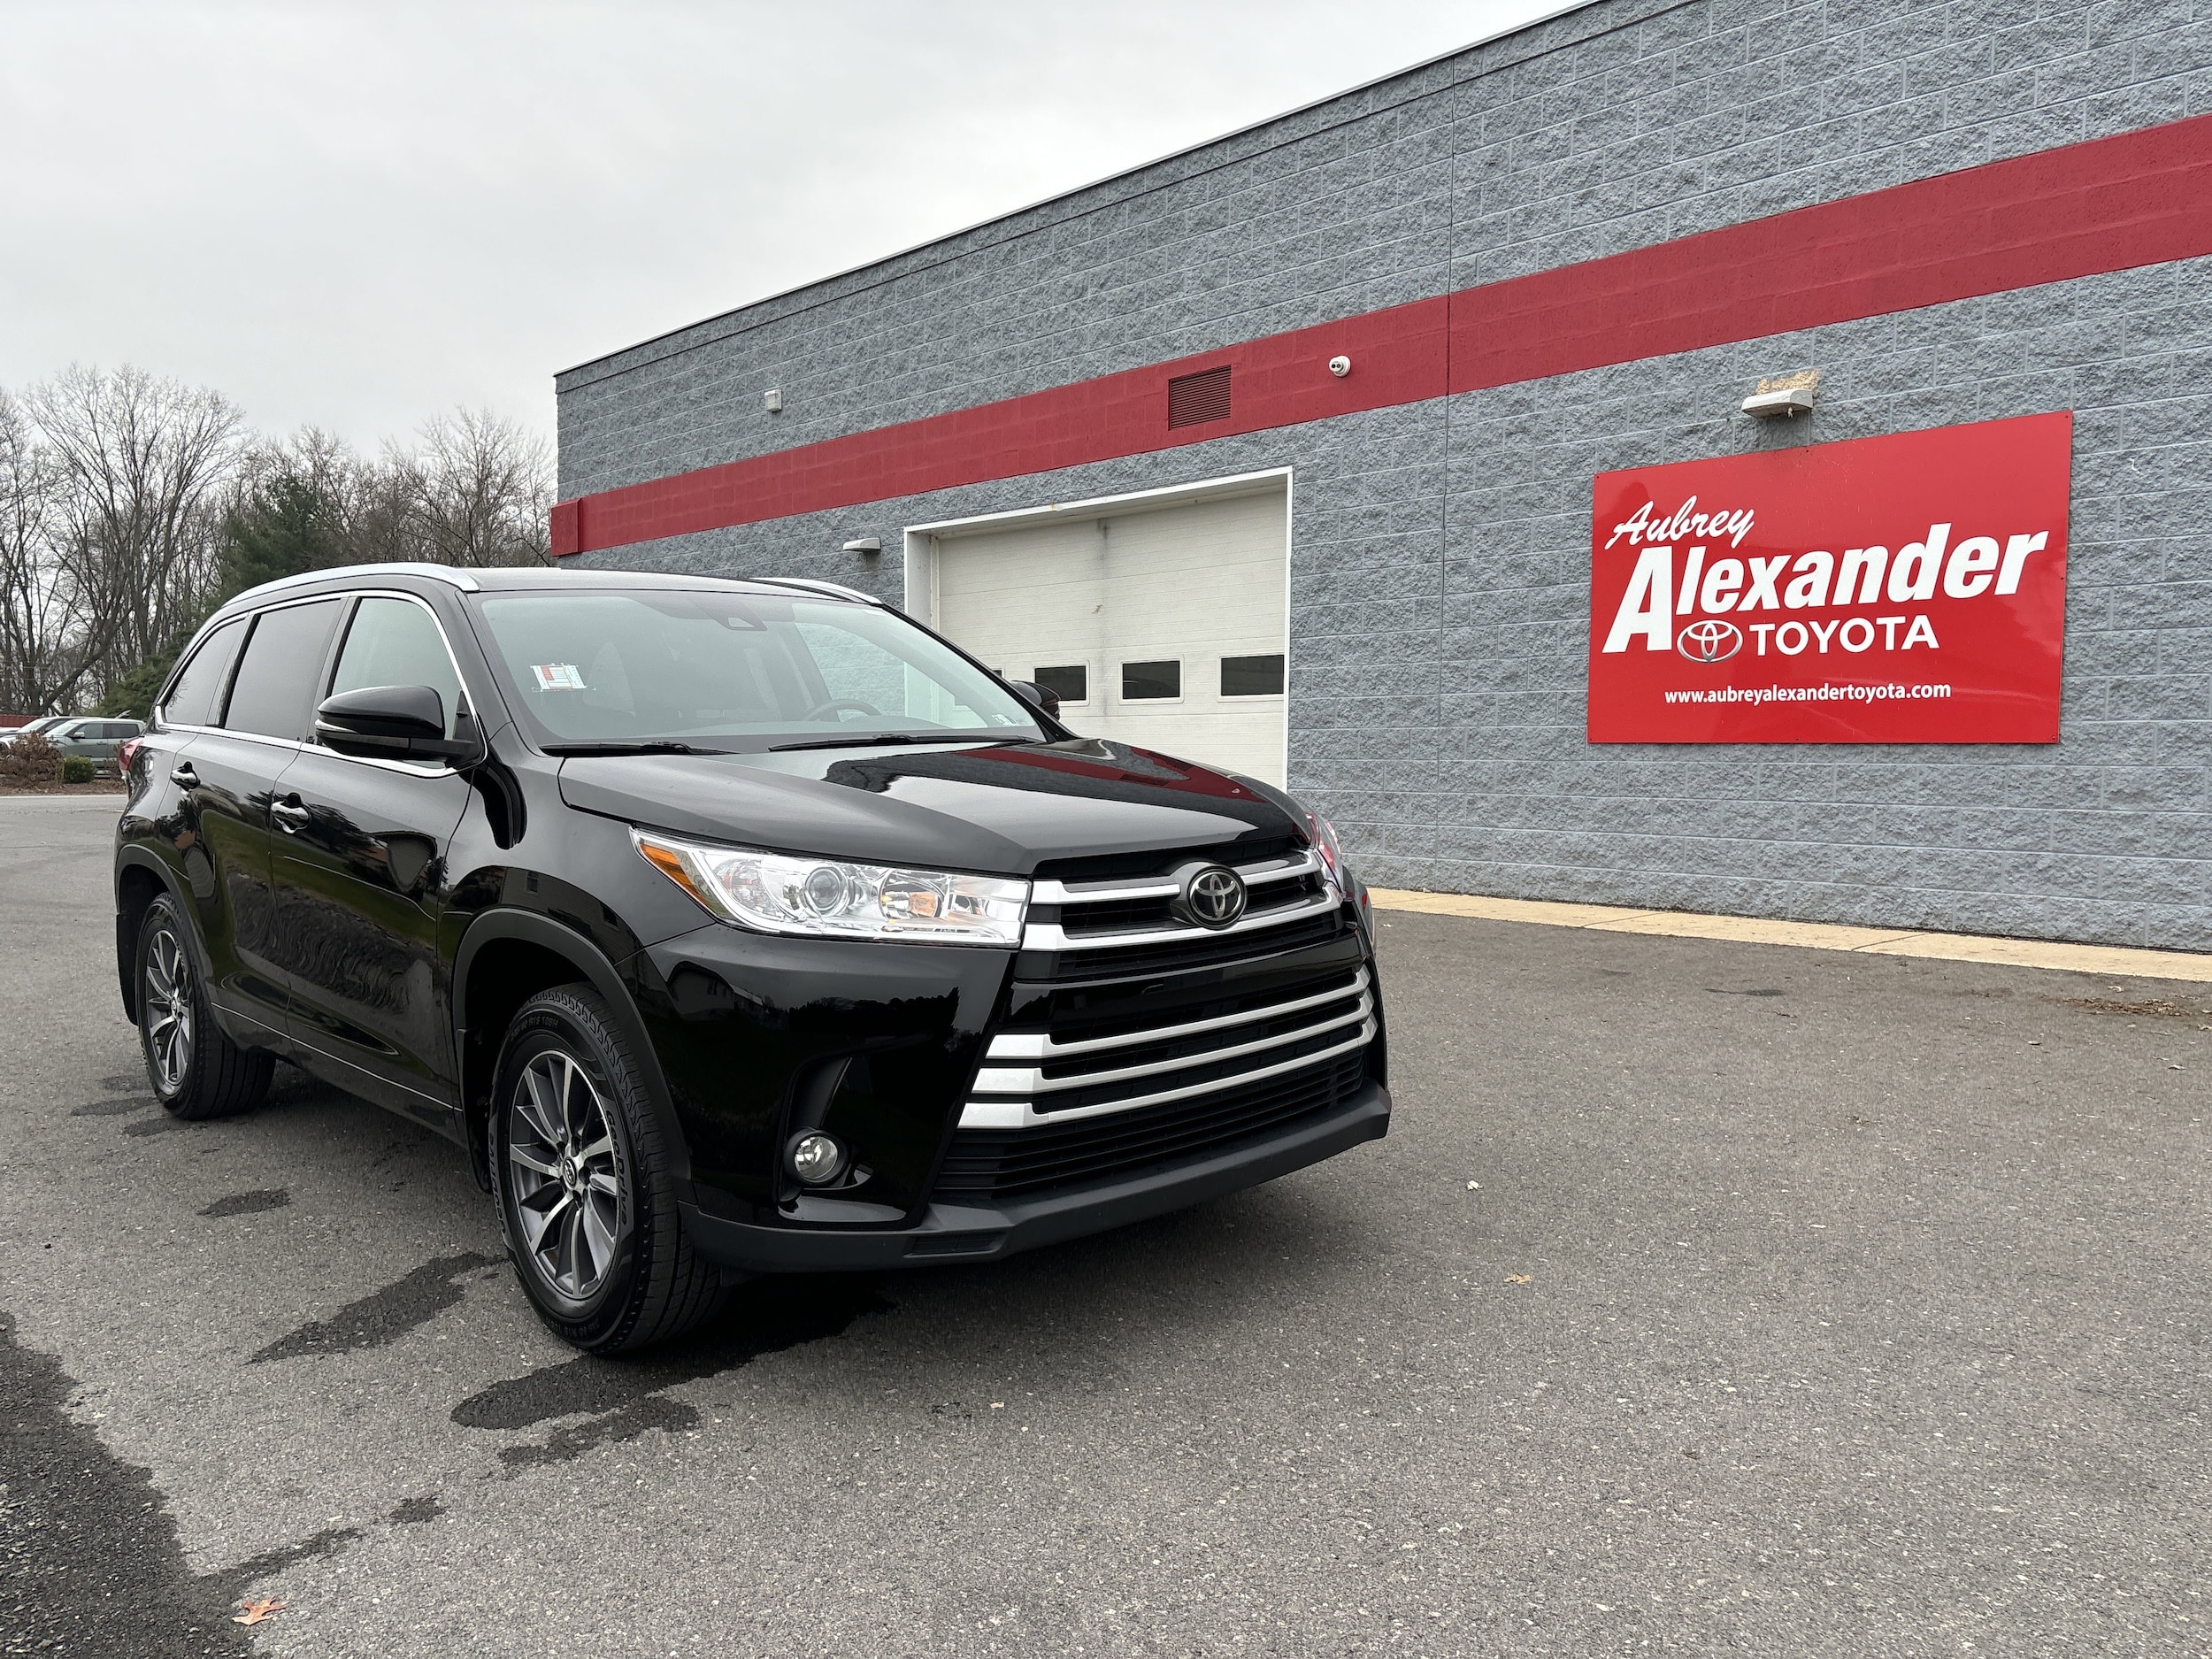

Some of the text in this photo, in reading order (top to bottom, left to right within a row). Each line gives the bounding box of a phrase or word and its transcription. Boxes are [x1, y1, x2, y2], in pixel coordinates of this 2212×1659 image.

[1605, 495, 1755, 549] Aubrey
[1602, 522, 2049, 653] Alexander
[1749, 614, 1940, 657] TOYOTA
[1664, 682, 1951, 706] www.aubreyalexandertoyota.com
